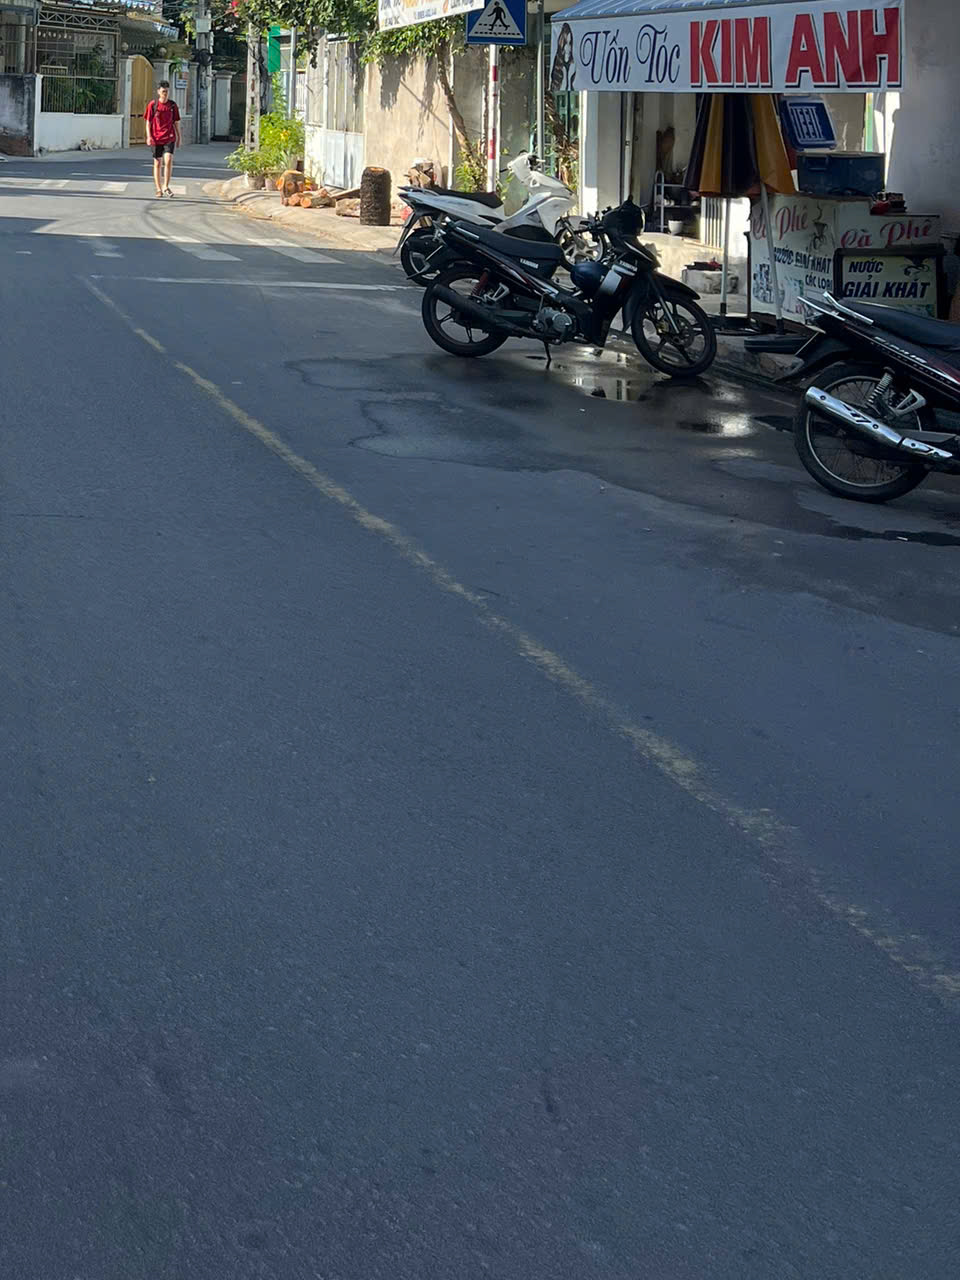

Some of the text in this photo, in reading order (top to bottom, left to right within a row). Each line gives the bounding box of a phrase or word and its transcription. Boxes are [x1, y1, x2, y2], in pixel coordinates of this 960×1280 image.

[580, 6, 903, 88] Uốn Tóc KIM ANH
[775, 204, 808, 240] Phê
[840, 219, 933, 249] Cà Phê
[848, 258, 884, 274] NƯỚC
[844, 274, 931, 299] GIẢI KHÁT
